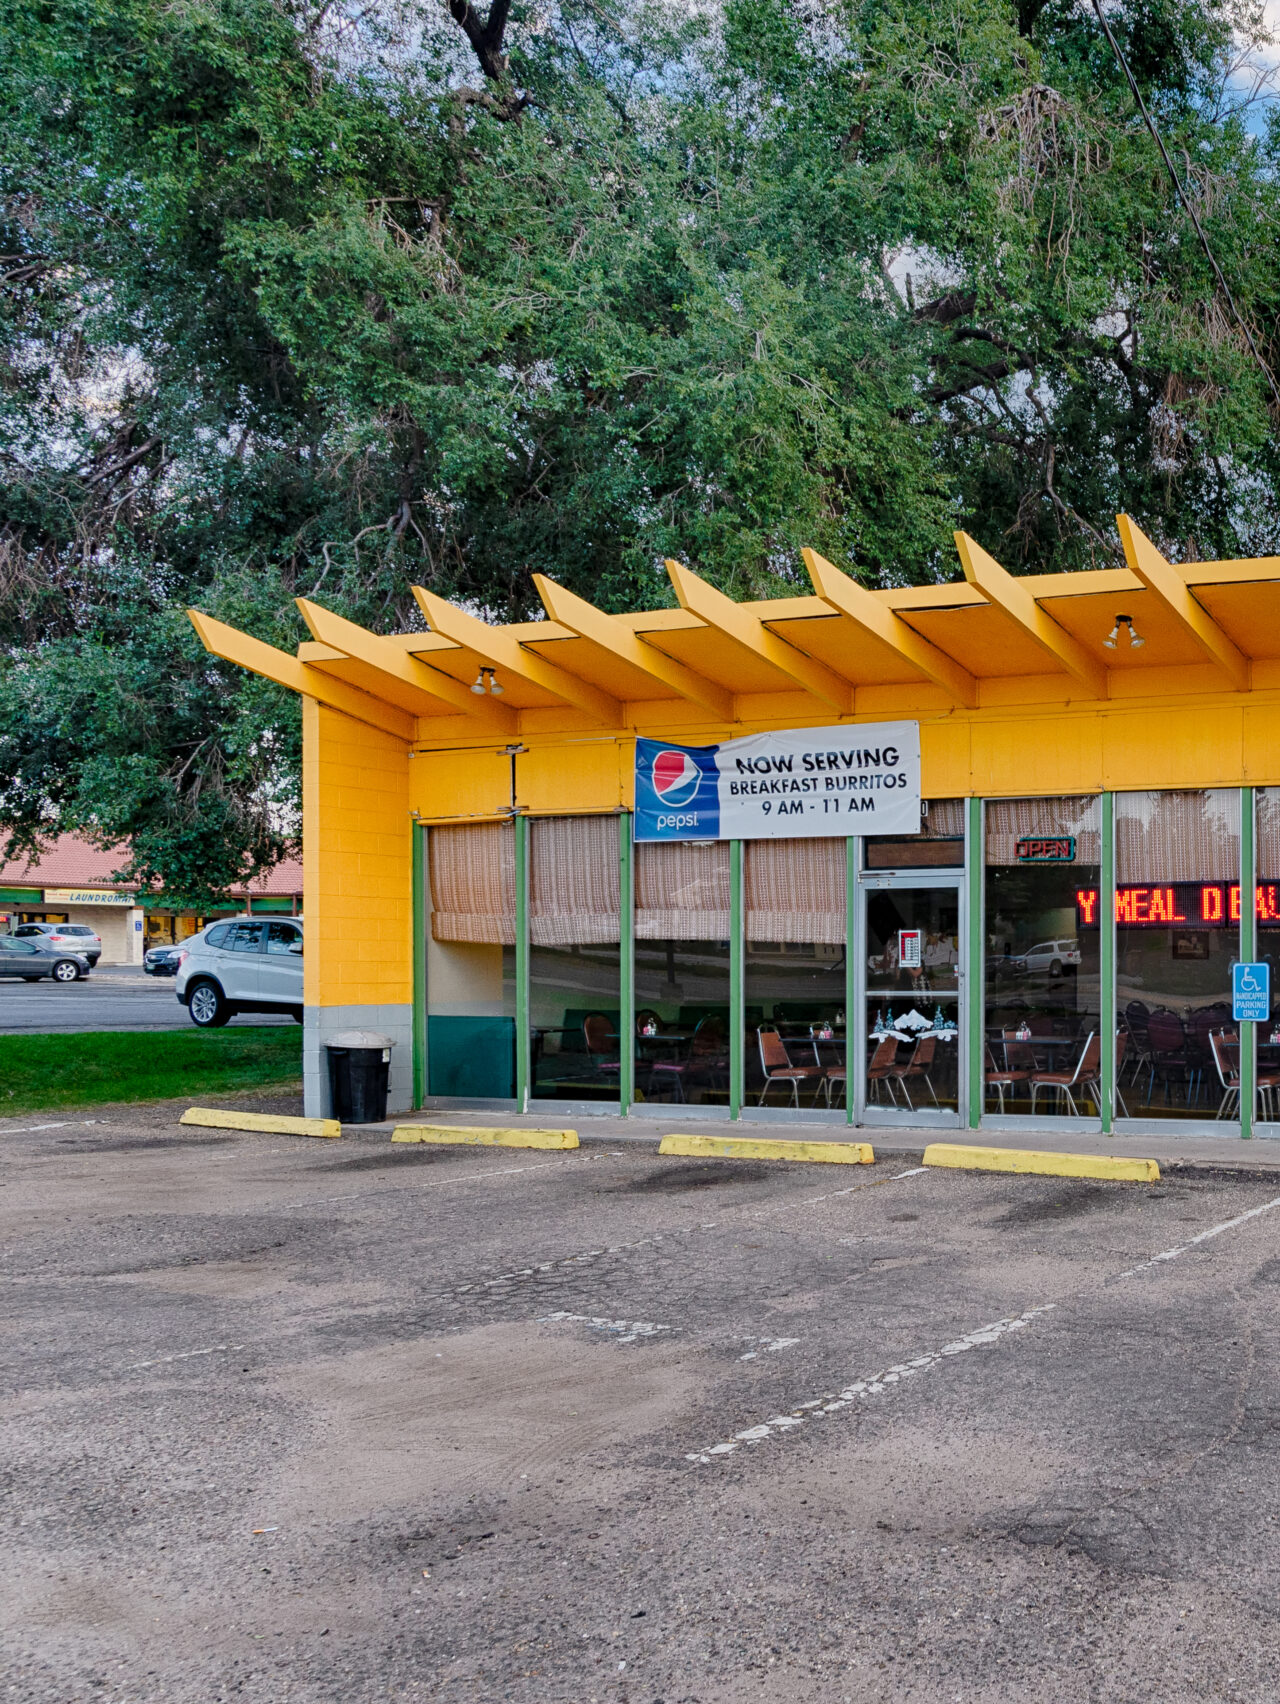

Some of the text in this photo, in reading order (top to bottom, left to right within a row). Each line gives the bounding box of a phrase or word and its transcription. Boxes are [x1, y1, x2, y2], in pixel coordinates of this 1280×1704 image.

[735, 747, 900, 775] NOW SERVING
[730, 773, 907, 796] BREAKFAST BURRITOS
[762, 801, 772, 816] 9
[777, 799, 804, 815] AM
[822, 799, 840, 813] 11
[847, 797, 875, 812] AM
[657, 811, 697, 831] pepsi
[1014, 840, 1069, 857] OPEN
[1114, 887, 1186, 922] MEAL
[1235, 992, 1267, 1001] HANDICAPPED
[1236, 1000, 1266, 1009] PARKING
[1242, 1009, 1260, 1018] ONLY
